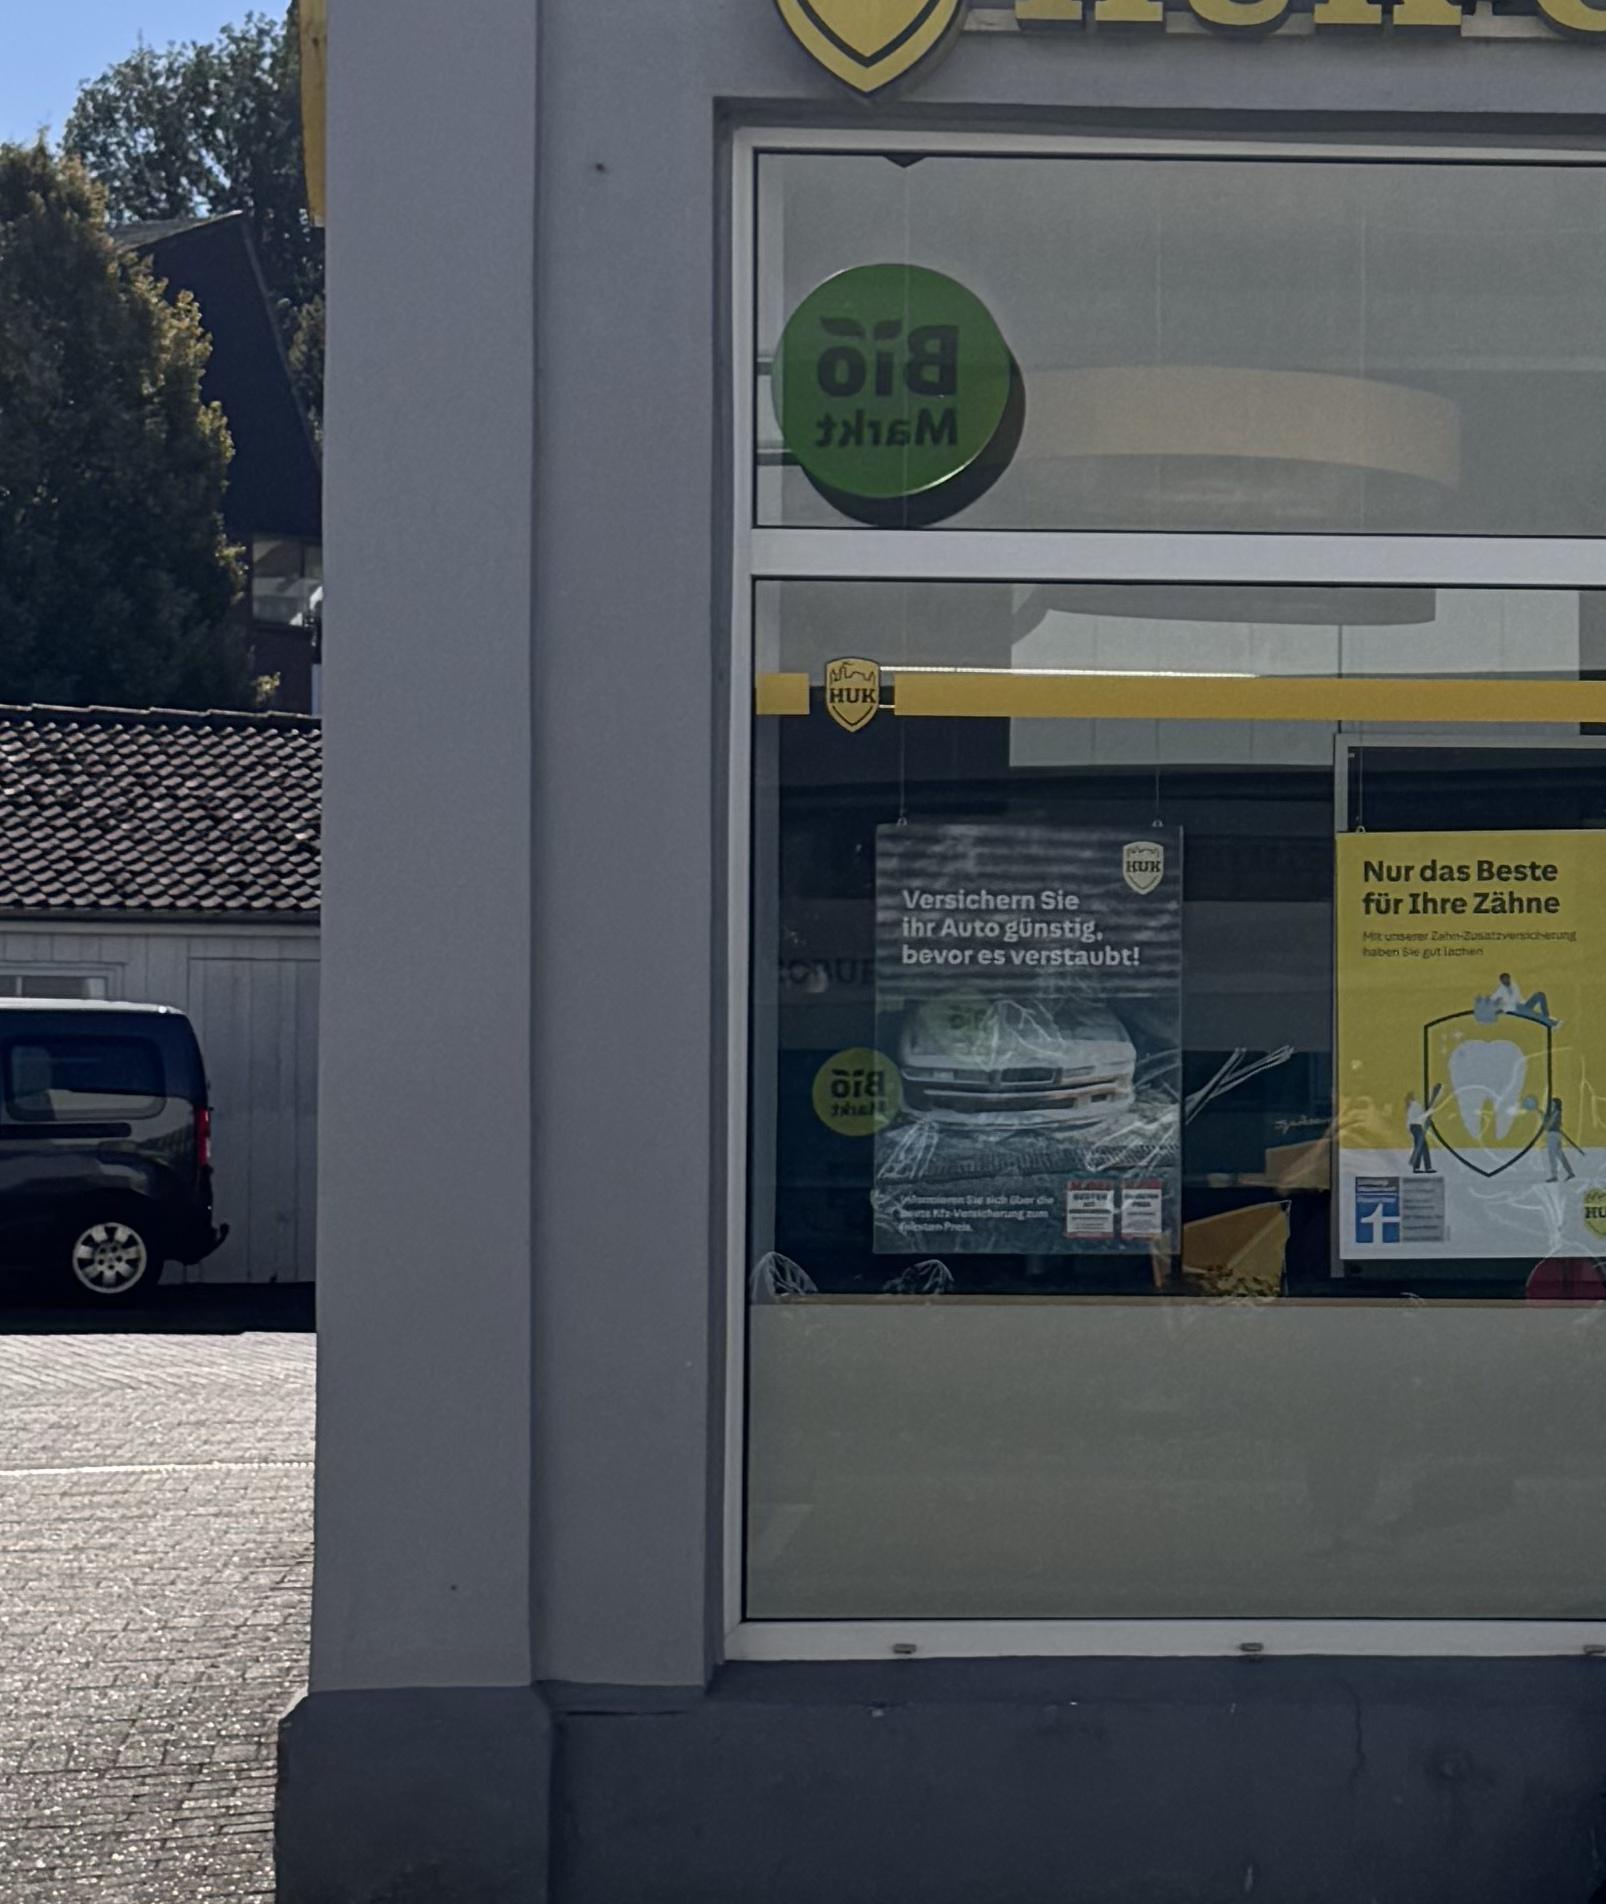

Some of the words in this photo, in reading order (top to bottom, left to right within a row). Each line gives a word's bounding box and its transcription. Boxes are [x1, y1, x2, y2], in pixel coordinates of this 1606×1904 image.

[828, 686, 877, 705] HUK
[1126, 859, 1162, 874] HUK
[1363, 860, 1415, 883] Nur
[1419, 859, 1471, 882] das
[1476, 859, 1559, 882] Beste
[902, 889, 1035, 910] Versichern
[1040, 889, 1080, 910] Sie
[1362, 892, 1404, 915] für
[1408, 891, 1469, 915] Ihre
[1472, 891, 1561, 915] Zähne
[940, 917, 1000, 938] Auto
[1003, 917, 1104, 943] günstig,
[901, 944, 973, 965] bevor
[977, 948, 1006, 965] es
[1010, 945, 1141, 966] verstaubt!
[1422, 947, 1442, 959] gut
